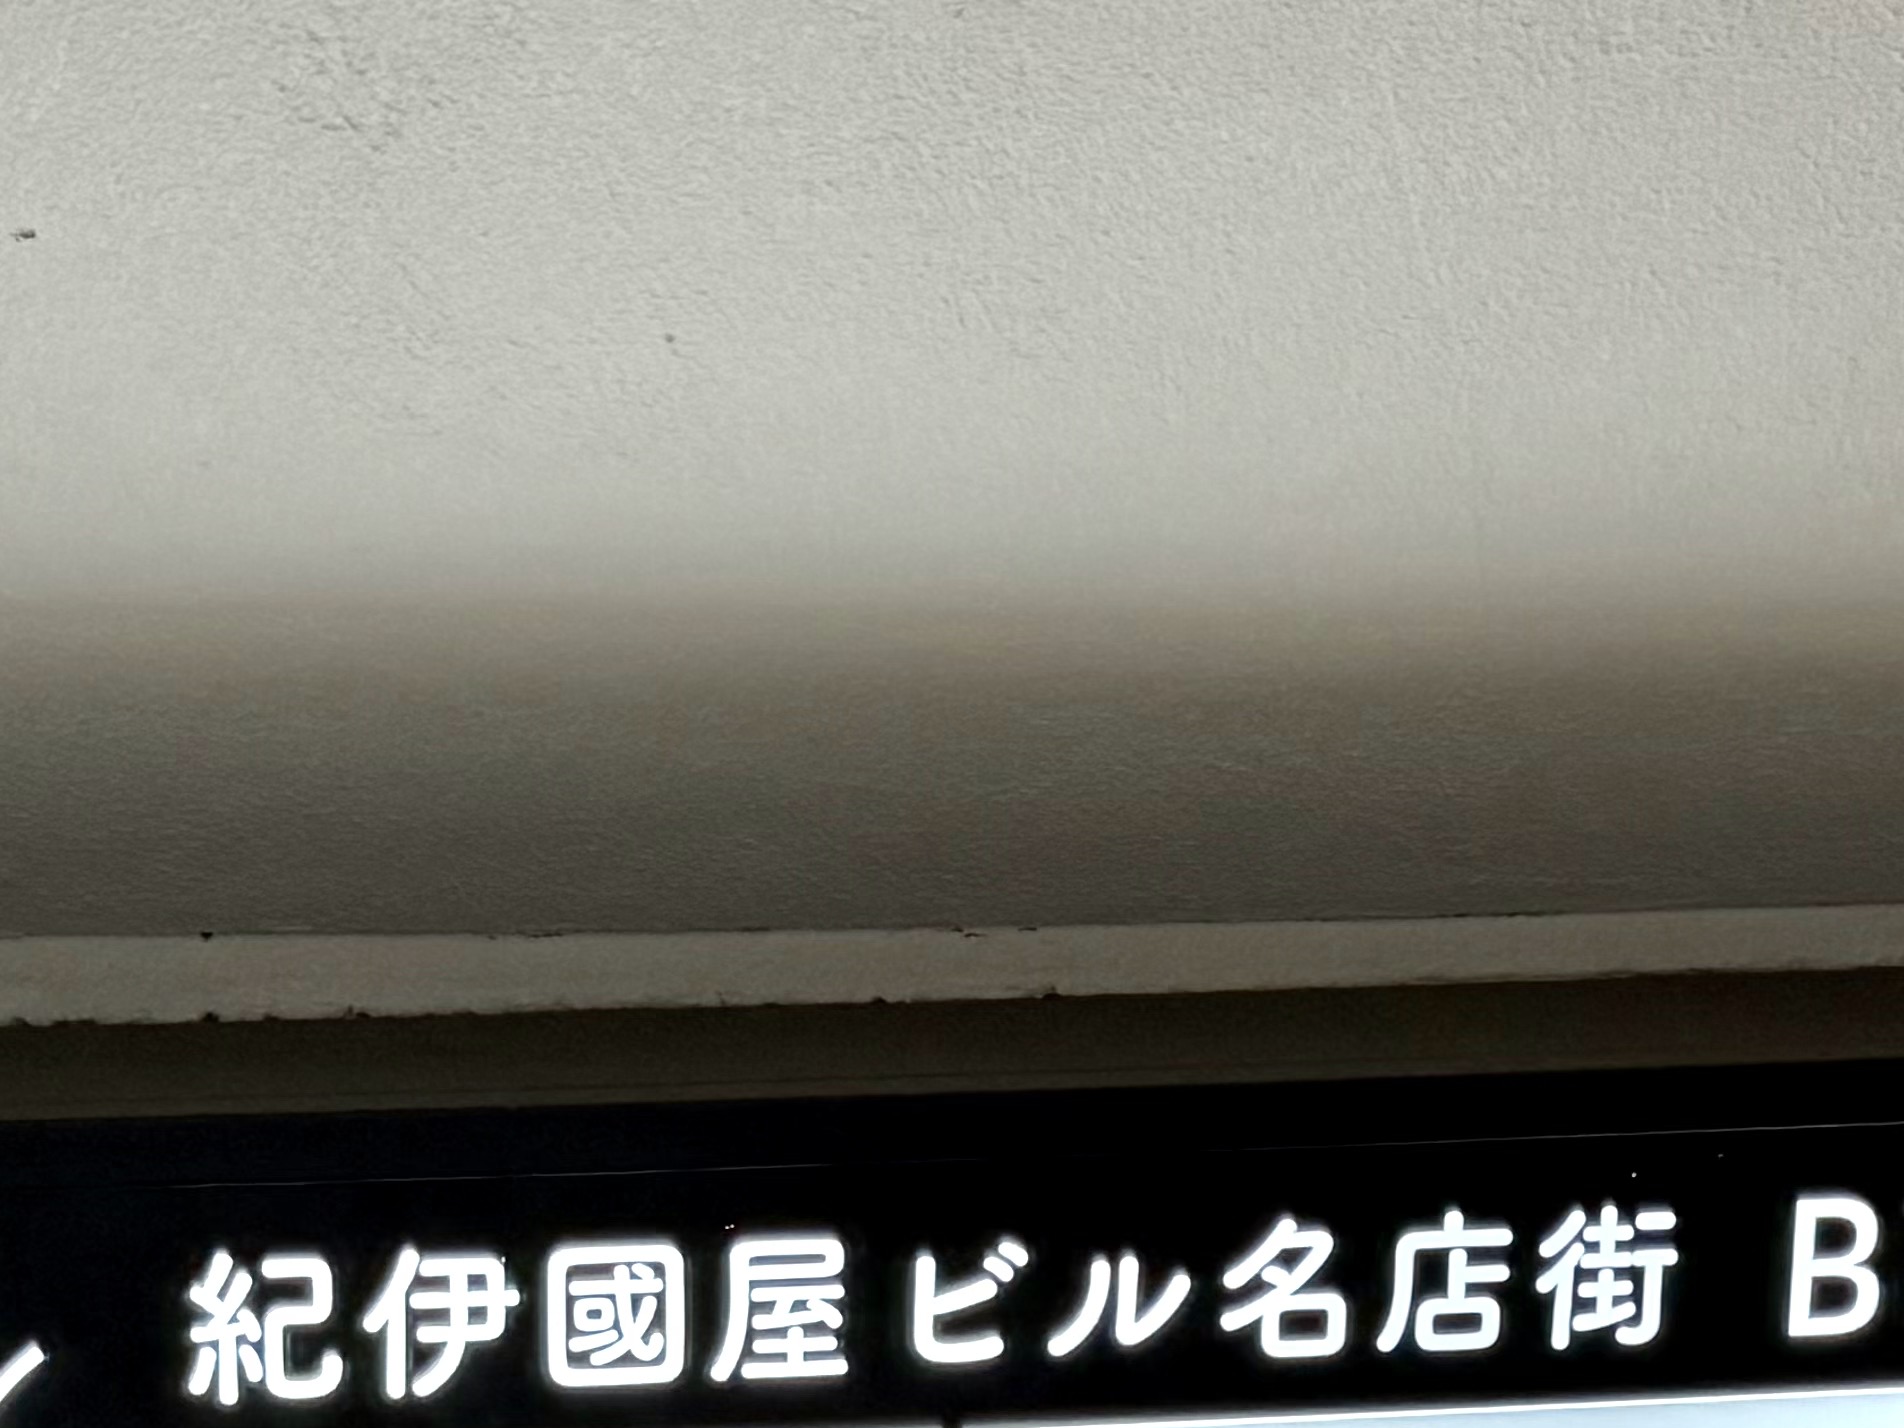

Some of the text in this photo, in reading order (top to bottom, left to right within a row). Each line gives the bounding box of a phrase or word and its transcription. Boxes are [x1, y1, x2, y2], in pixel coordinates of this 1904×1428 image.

[185, 1203, 1679, 1406] 紀伊國屋ビル名店街
